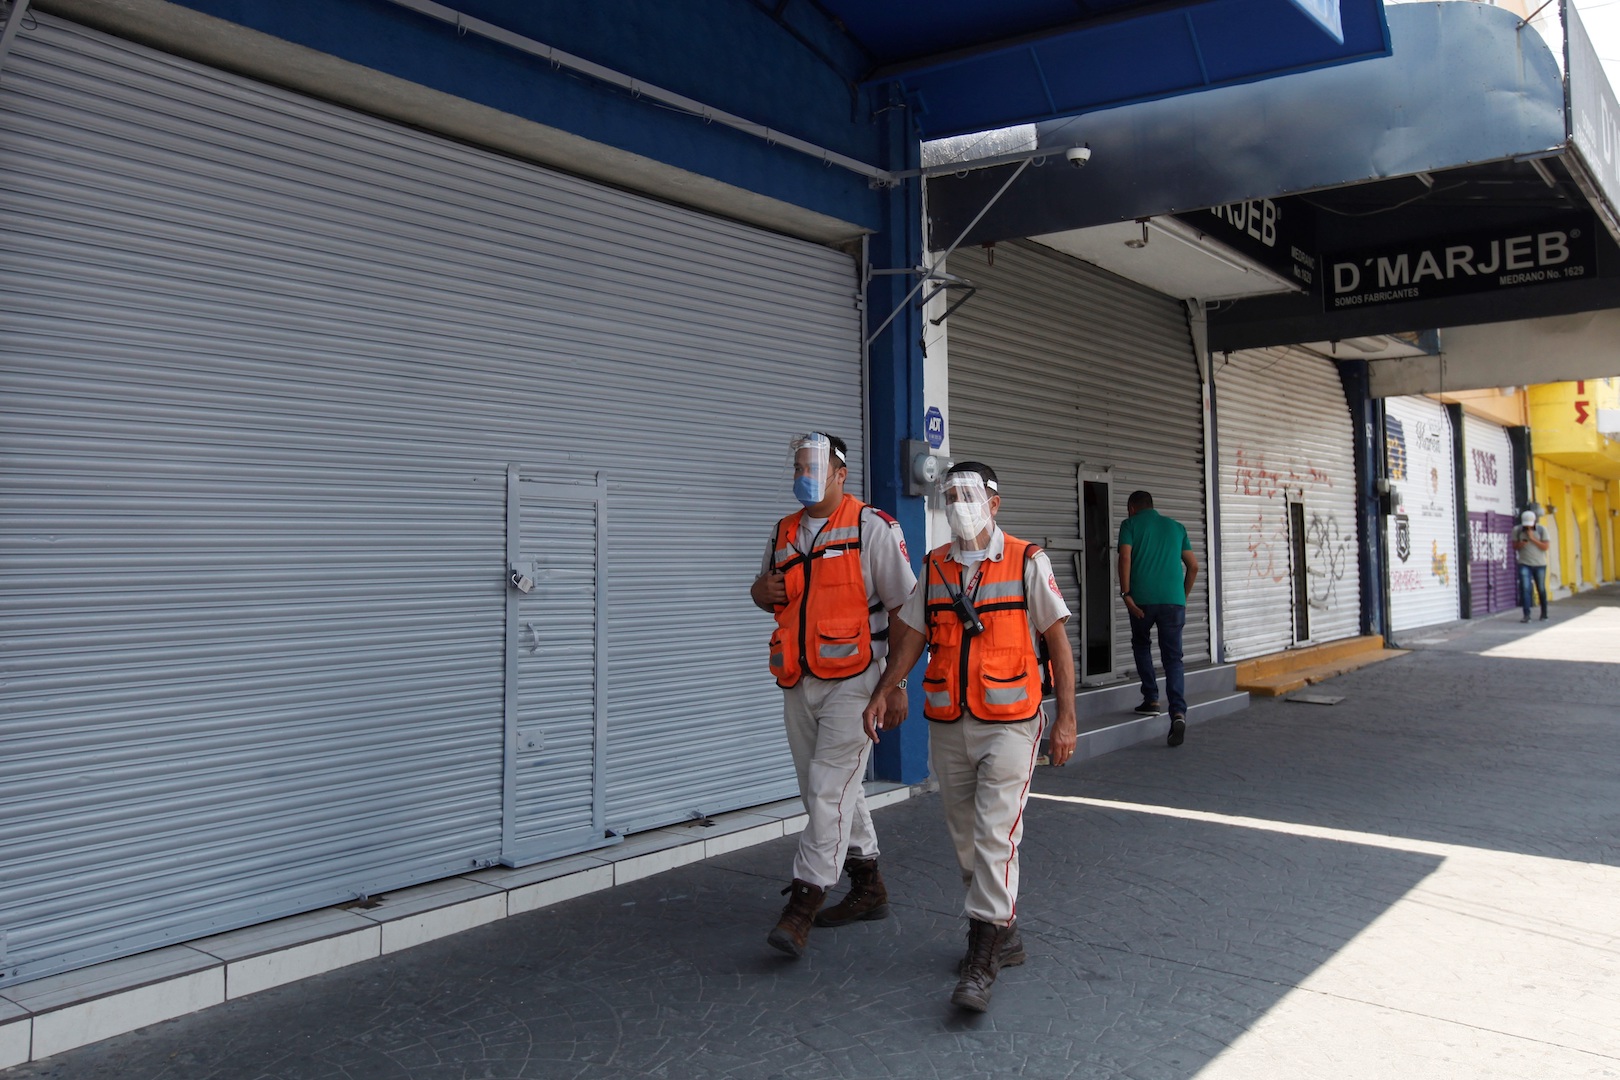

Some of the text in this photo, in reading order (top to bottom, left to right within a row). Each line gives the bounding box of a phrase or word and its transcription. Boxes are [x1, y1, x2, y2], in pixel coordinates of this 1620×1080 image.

[1499, 265, 1585, 286] MEDRANO No. 1629
[1334, 287, 1419, 307] SOMOS FABRICANTES
[929, 417, 941, 432] ADT
